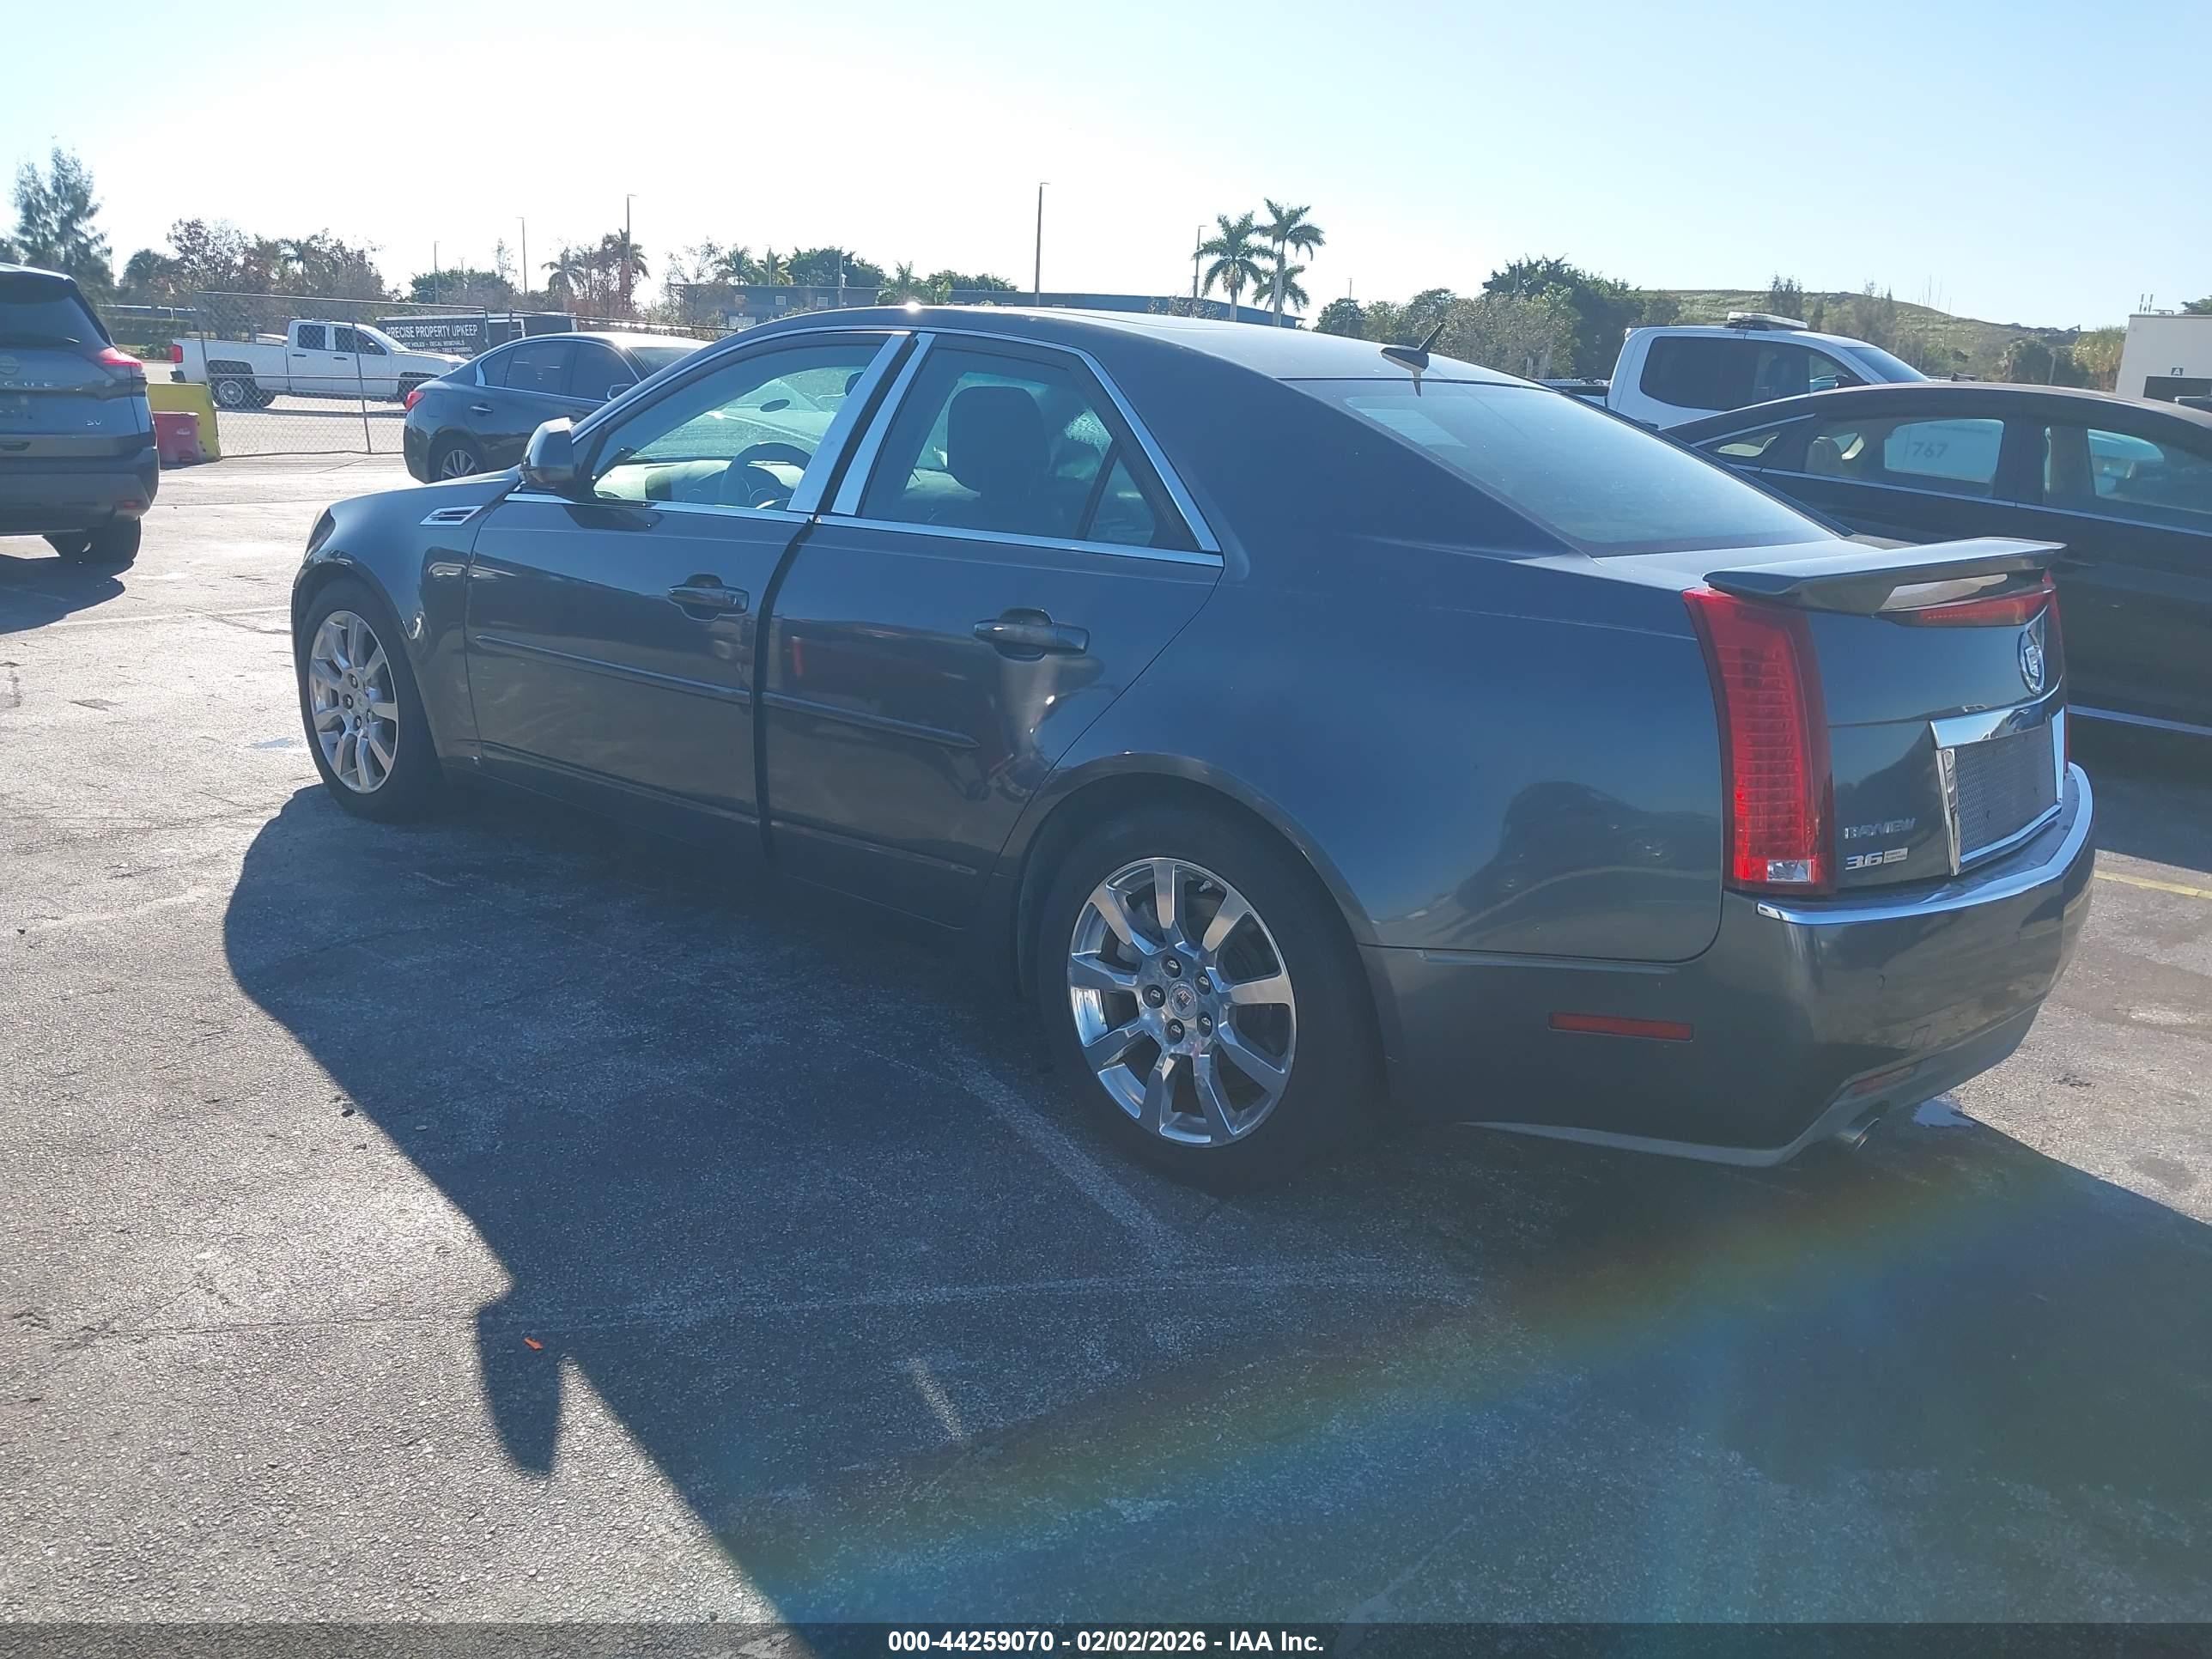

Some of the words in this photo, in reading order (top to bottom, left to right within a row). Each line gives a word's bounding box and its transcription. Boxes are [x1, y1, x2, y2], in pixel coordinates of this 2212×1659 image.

[386, 325, 415, 338] PRECISE
[415, 325, 450, 337] PROPERTY
[451, 324, 478, 337] UPKEEP
[1912, 441, 1948, 459] 767
[1844, 817, 1916, 839] BAYVIEW
